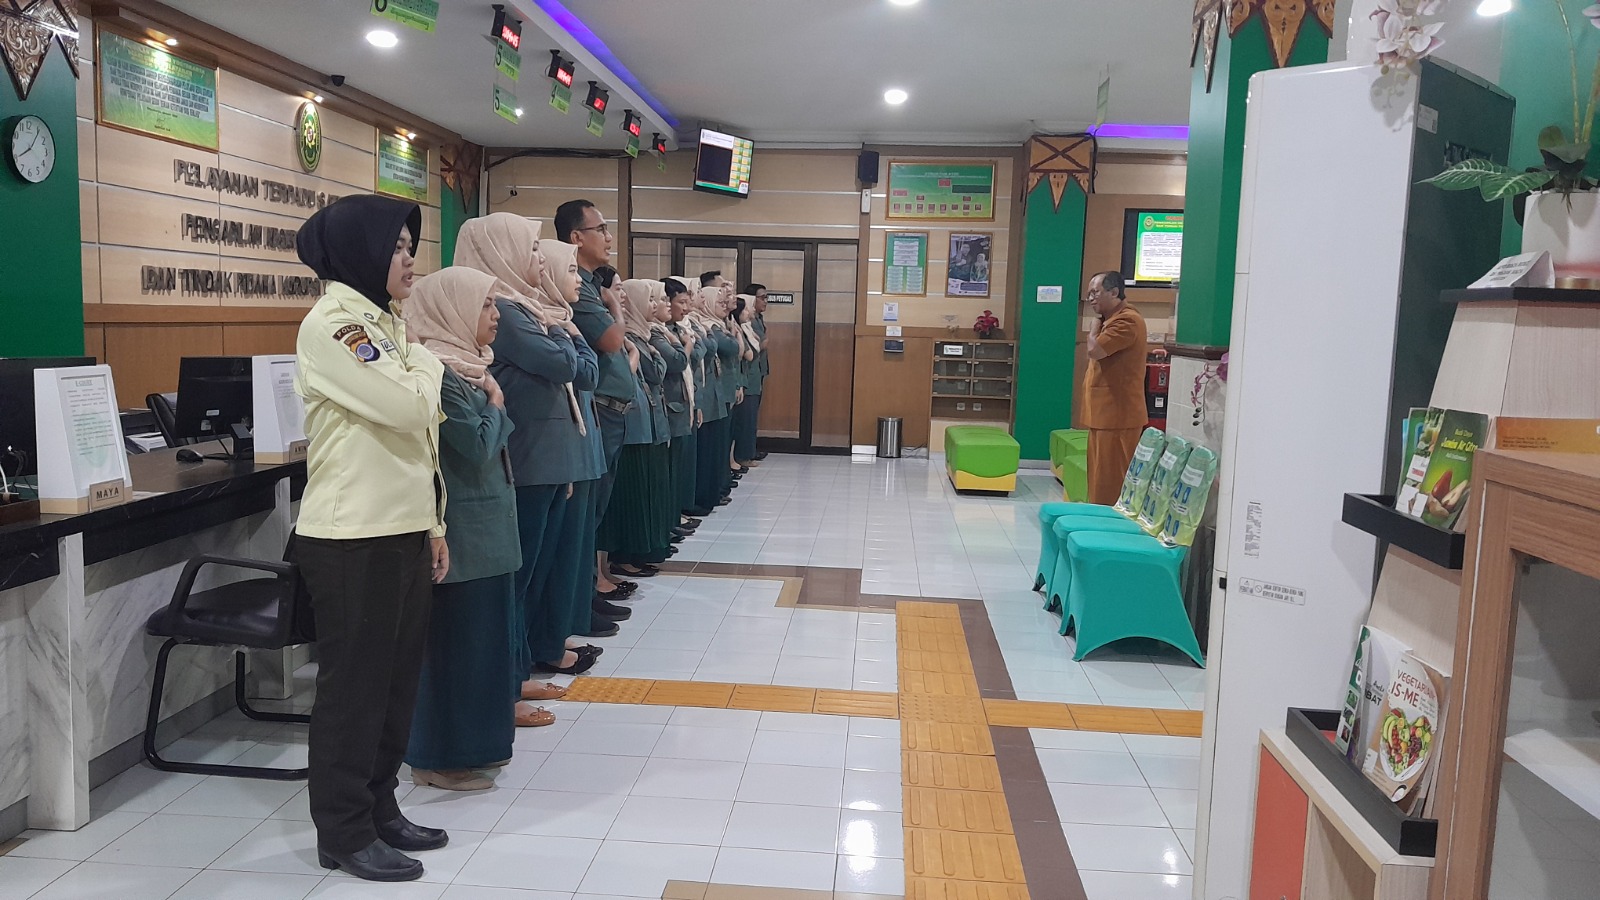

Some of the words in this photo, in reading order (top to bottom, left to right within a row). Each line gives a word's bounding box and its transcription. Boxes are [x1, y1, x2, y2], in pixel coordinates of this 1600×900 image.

[26, 121, 32, 130] 12
[41, 136, 46, 145] 2
[20, 164, 24, 172] 7
[28, 169, 32, 177] 6
[174, 159, 259, 198] PELAYANAN
[263, 226, 298, 253] NEGER
[178, 268, 233, 297] TINDAK
[336, 325, 362, 338] POLDA
[96, 487, 119, 499] MAYA
